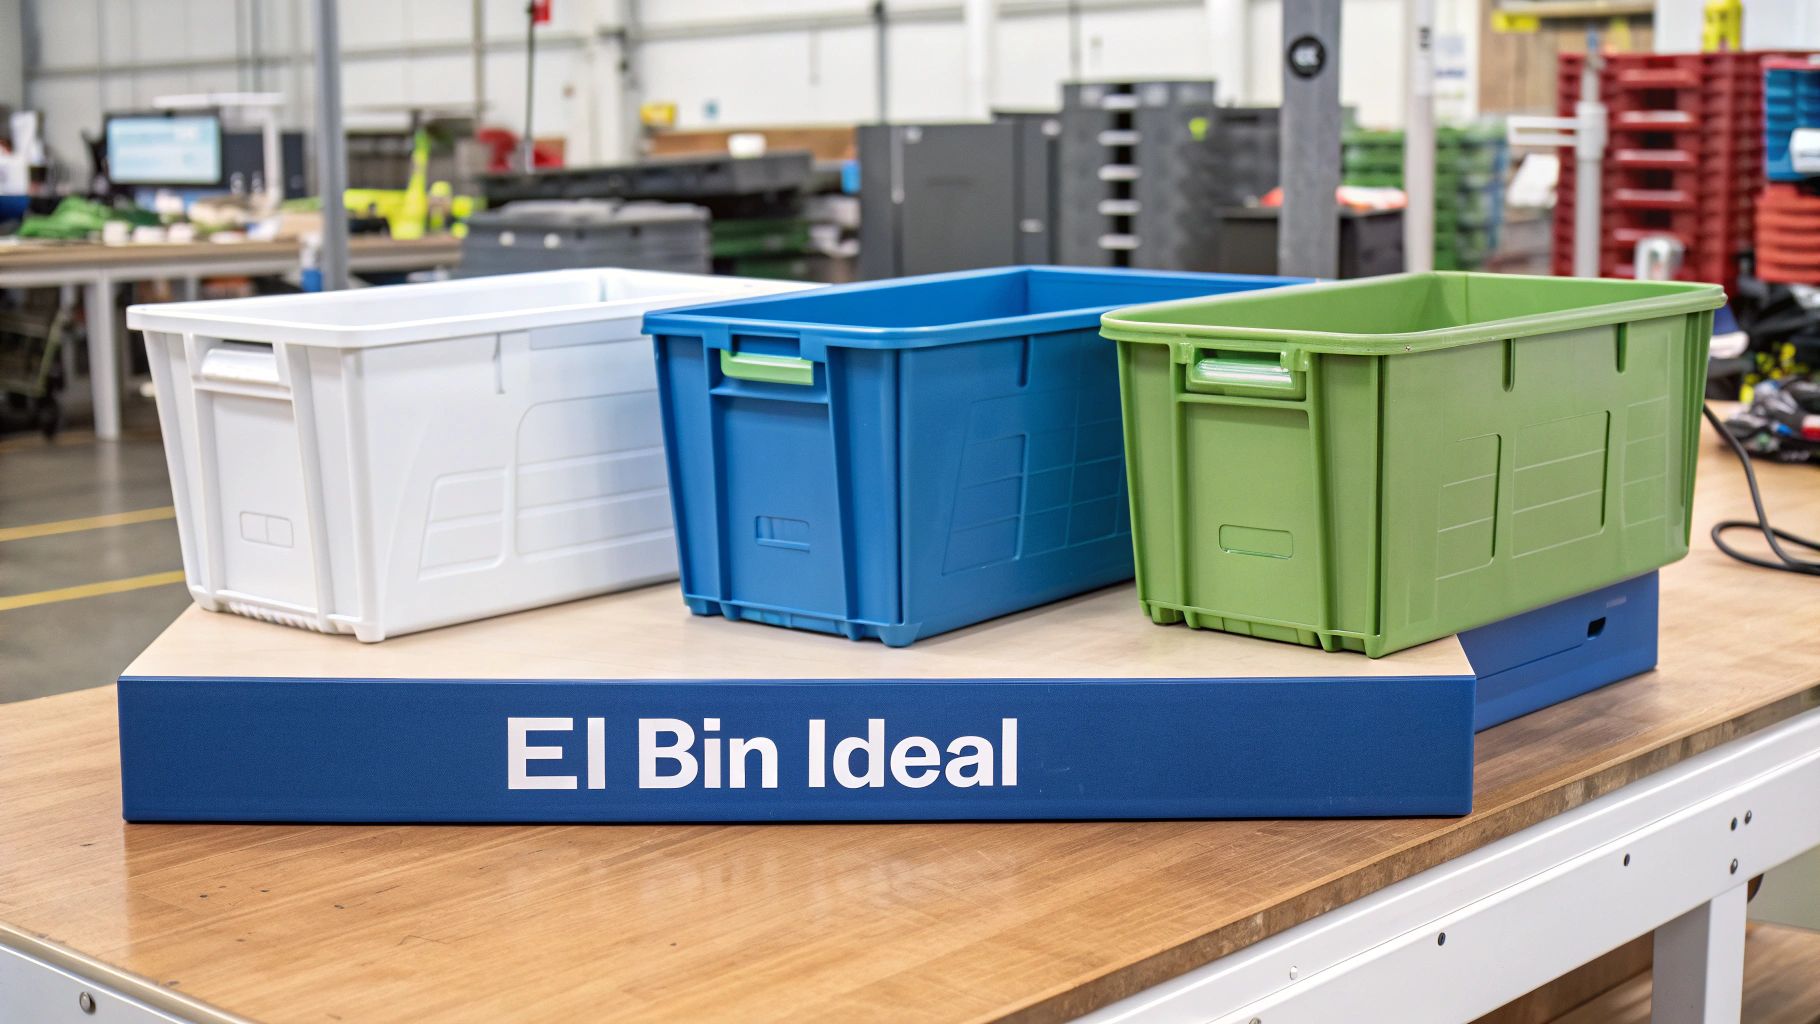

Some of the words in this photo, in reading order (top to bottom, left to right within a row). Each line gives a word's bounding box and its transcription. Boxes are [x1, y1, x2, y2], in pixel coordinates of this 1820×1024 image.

[507, 717, 606, 790] El
[638, 717, 778, 790] Bin
[808, 717, 1018, 788] Ideal
